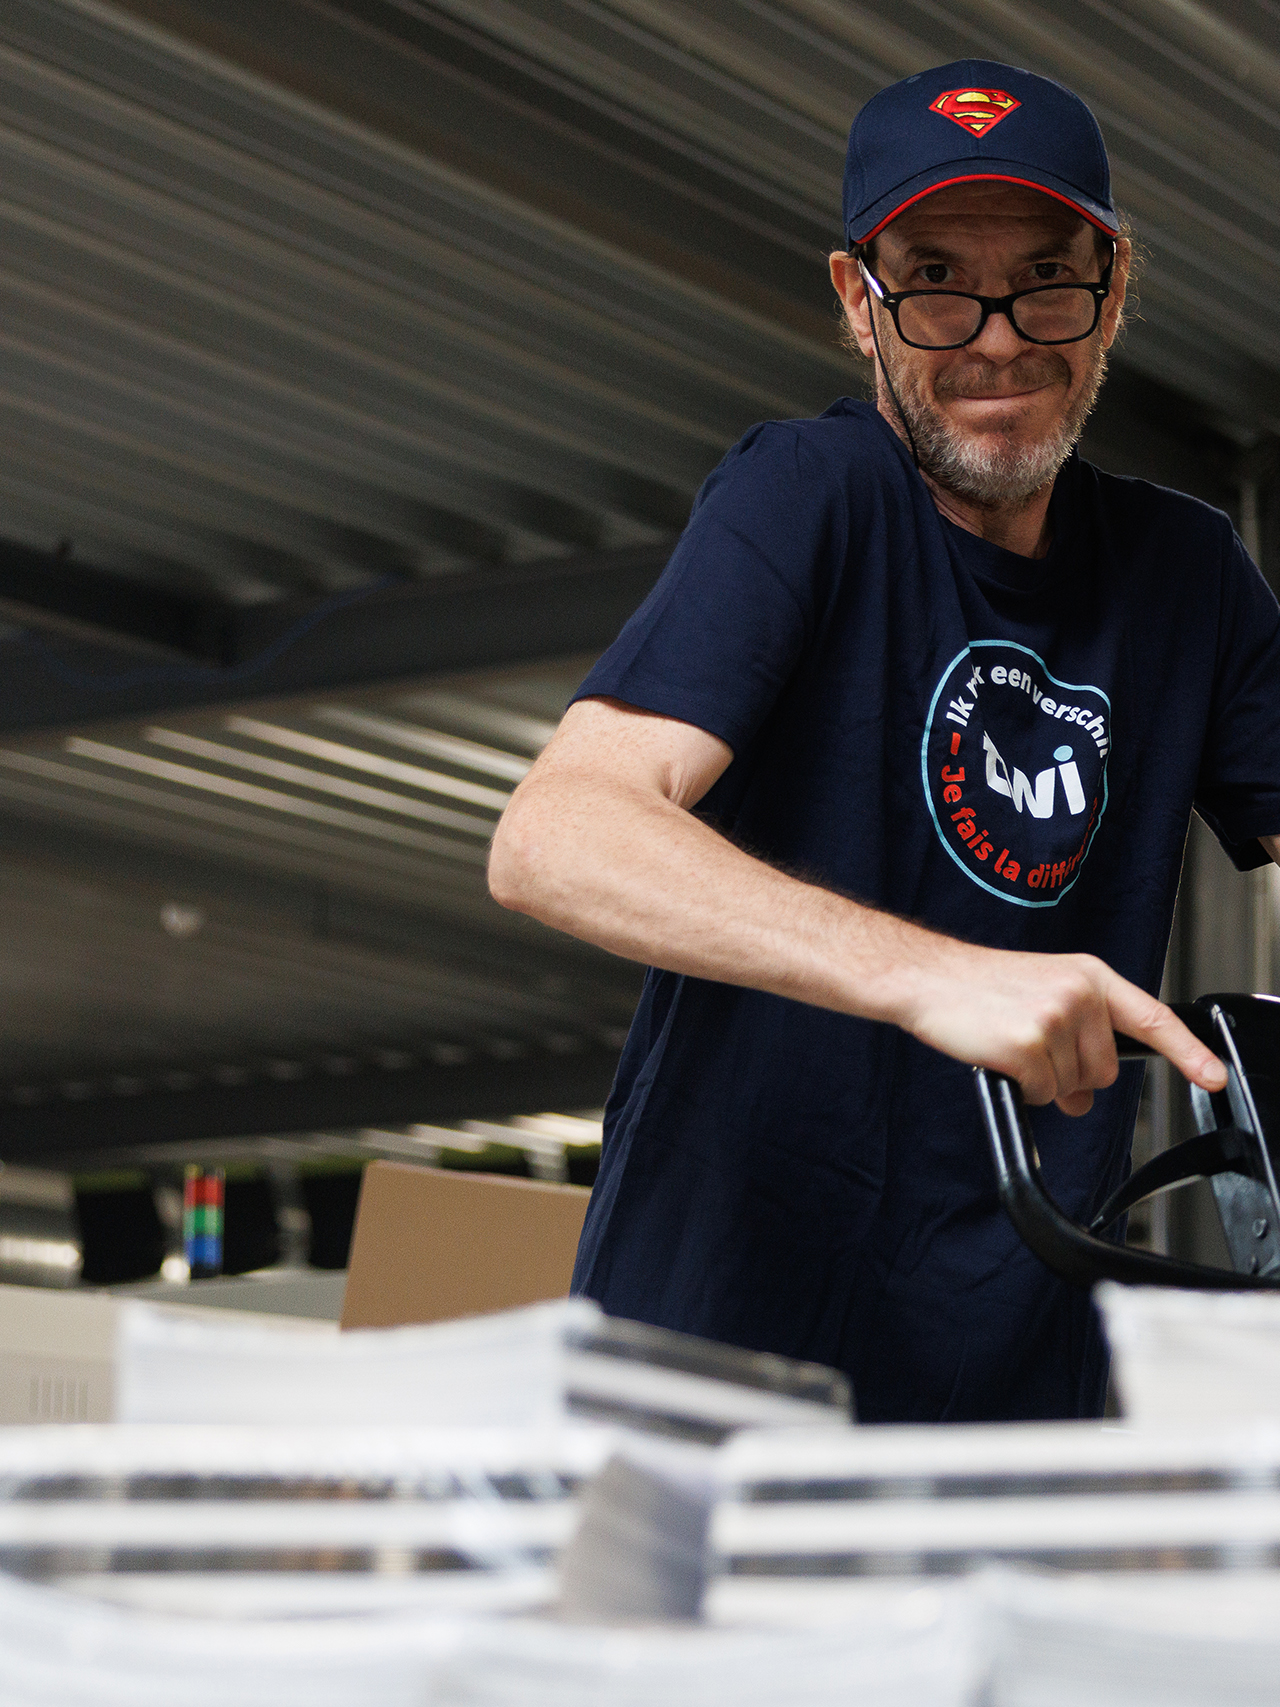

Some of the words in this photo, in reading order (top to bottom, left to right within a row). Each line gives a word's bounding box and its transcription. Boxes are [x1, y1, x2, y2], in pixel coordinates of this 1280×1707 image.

[946, 696, 974, 727] Ik
[991, 666, 1031, 694] een
[941, 765, 965, 803] Je
[951, 807, 993, 860] fais
[994, 849, 1021, 881] la
